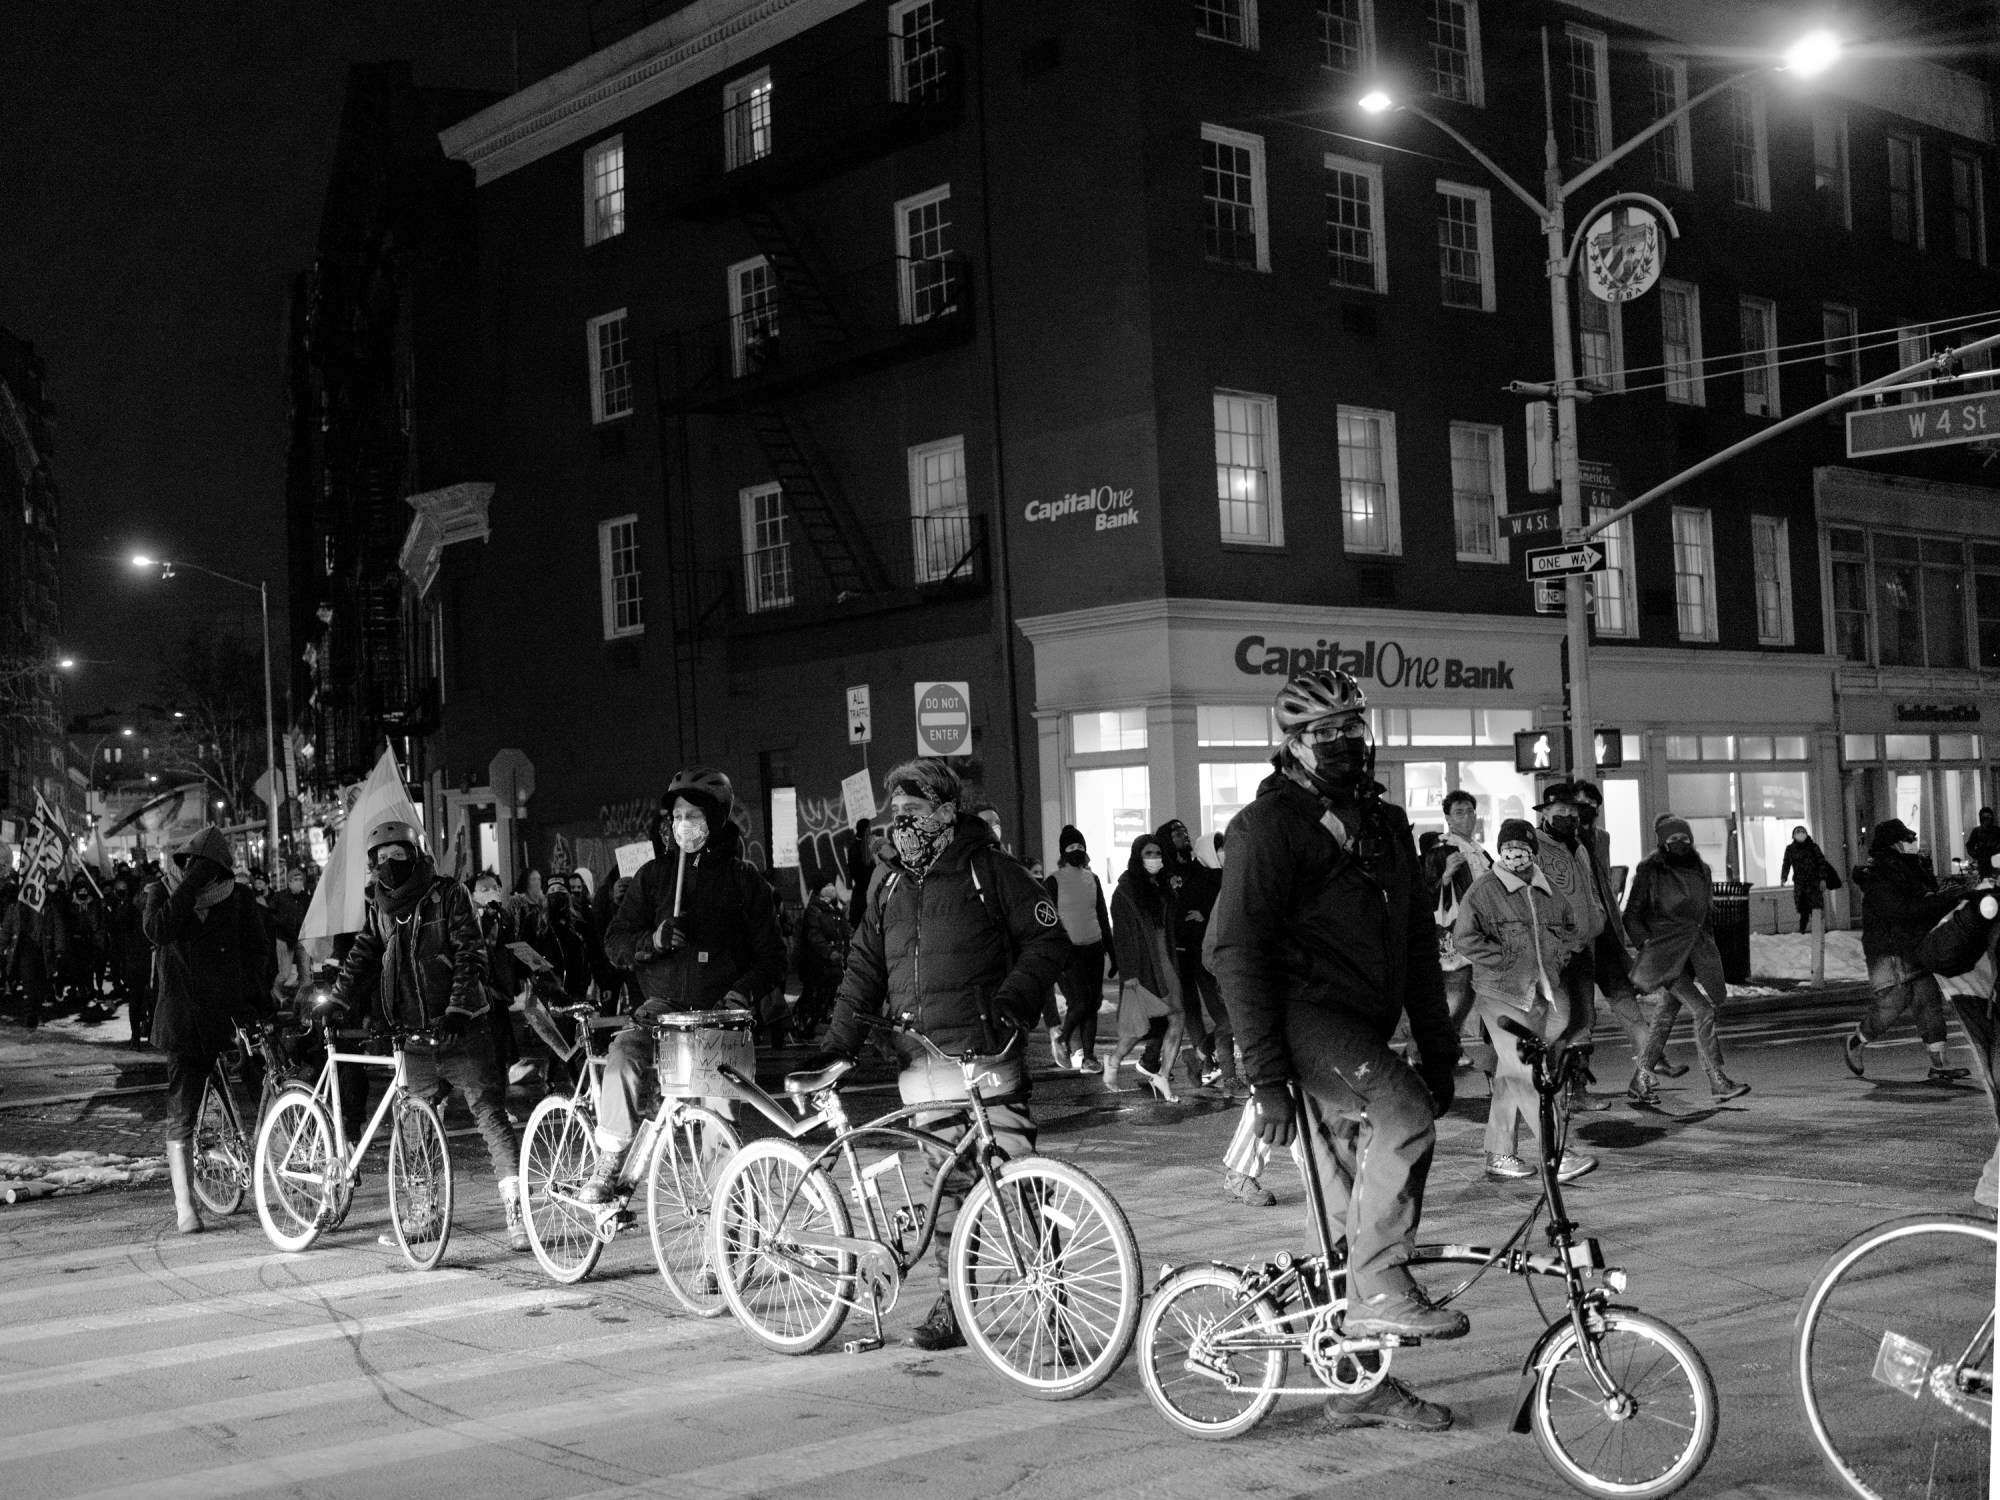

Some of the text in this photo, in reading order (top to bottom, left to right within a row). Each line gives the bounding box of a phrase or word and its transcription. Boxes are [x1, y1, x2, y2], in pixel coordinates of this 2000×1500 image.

[1606, 287, 1643, 300] CUBA
[1908, 405, 1987, 439] W 4 St
[1591, 490, 1611, 507] 6 Av
[1095, 507, 1139, 531] Bank
[1511, 514, 1548, 534] W 4 St
[1538, 552, 1594, 570] ONE WAY
[1540, 591, 1559, 603] ONE
[1444, 658, 1515, 690] Bank
[852, 689, 865, 706] ALL
[925, 697, 959, 709] DO NOT
[849, 707, 869, 720] TRAFFIC
[929, 729, 959, 741] ENTER
[698, 1033, 738, 1052] What
